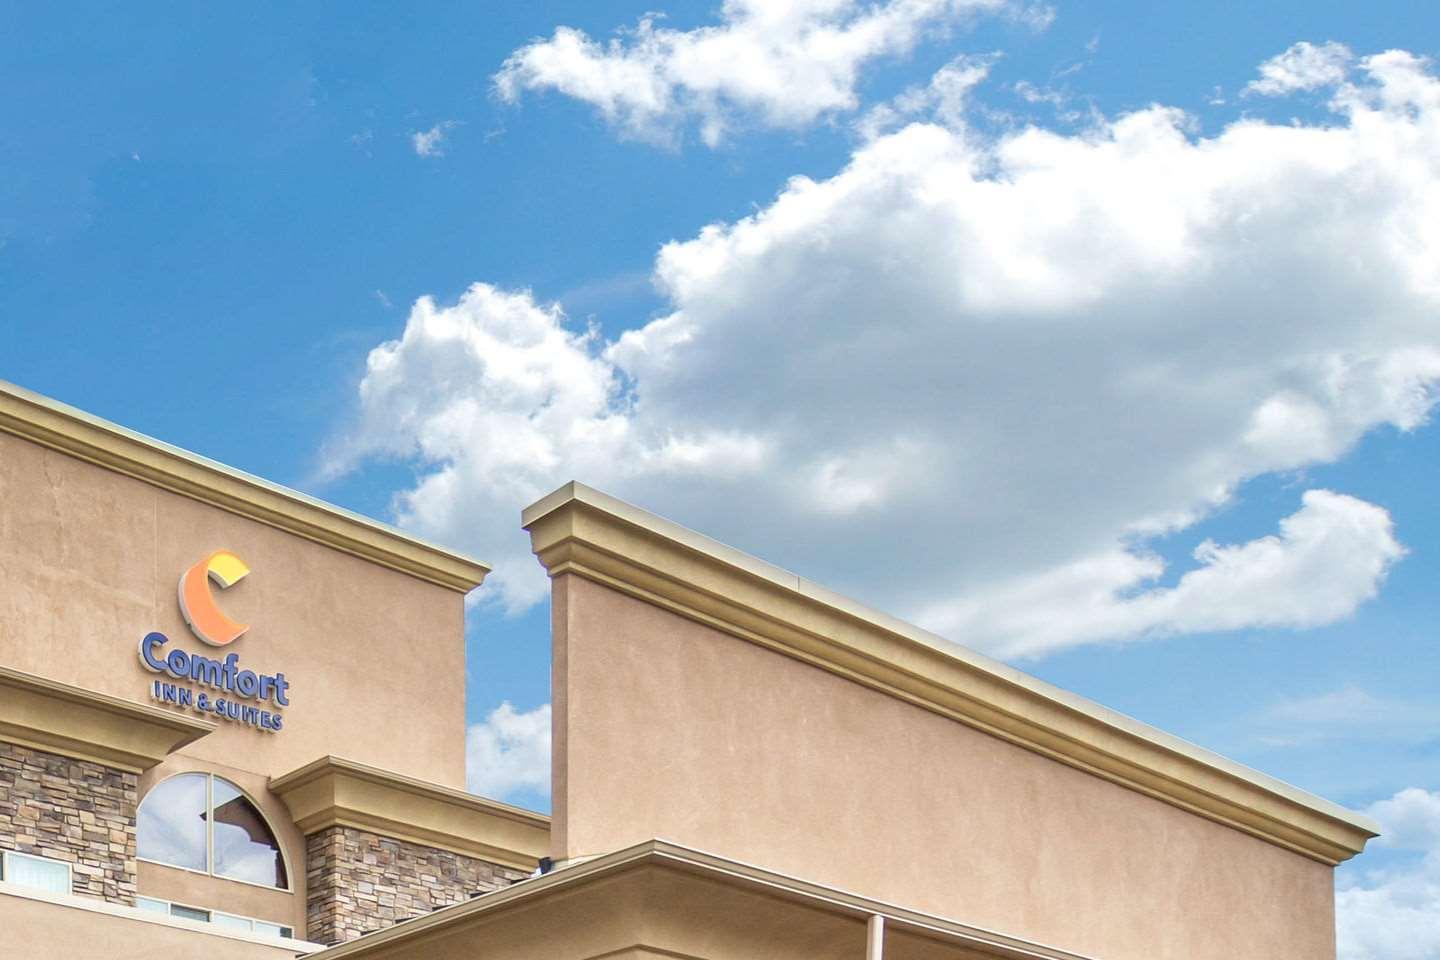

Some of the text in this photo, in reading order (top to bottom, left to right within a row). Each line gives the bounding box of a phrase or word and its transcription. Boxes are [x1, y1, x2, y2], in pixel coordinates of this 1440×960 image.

[140, 631, 289, 707] Comfort
[152, 680, 284, 732] INN & SUITES
